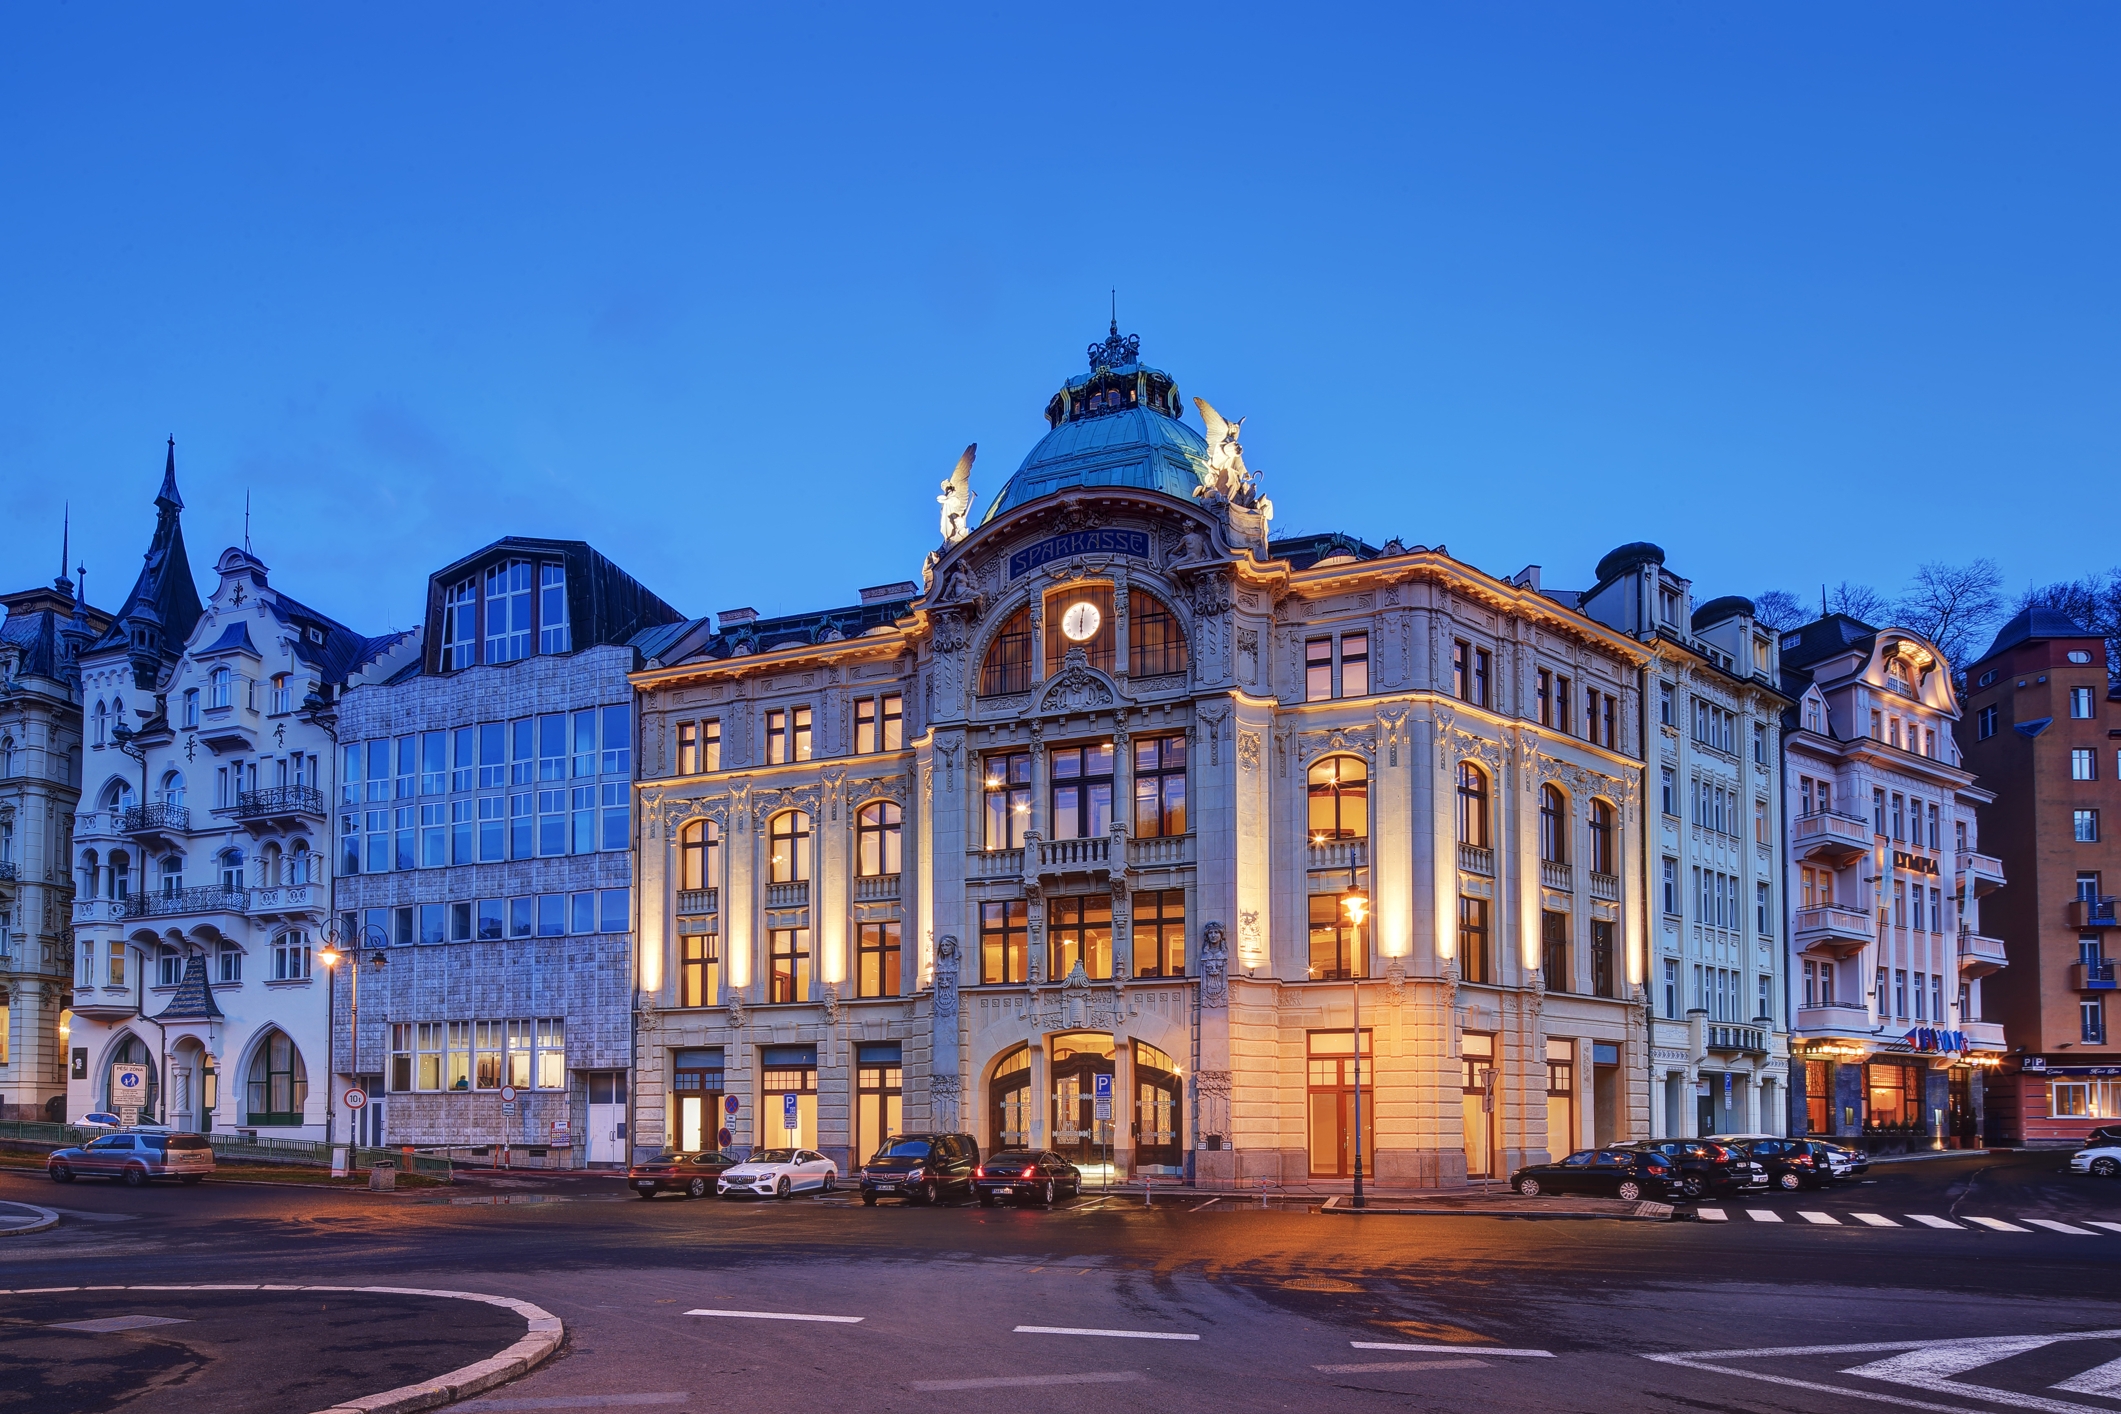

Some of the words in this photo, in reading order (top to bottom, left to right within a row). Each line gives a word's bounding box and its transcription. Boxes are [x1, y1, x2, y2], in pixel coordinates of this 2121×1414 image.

[1015, 532, 1143, 574] SPARKASSE
[1892, 850, 1940, 876] LYMPIA
[2024, 1058, 2031, 1067] P
[2036, 1058, 2043, 1066] P
[1098, 1077, 1109, 1091] P
[786, 1096, 795, 1109] P
